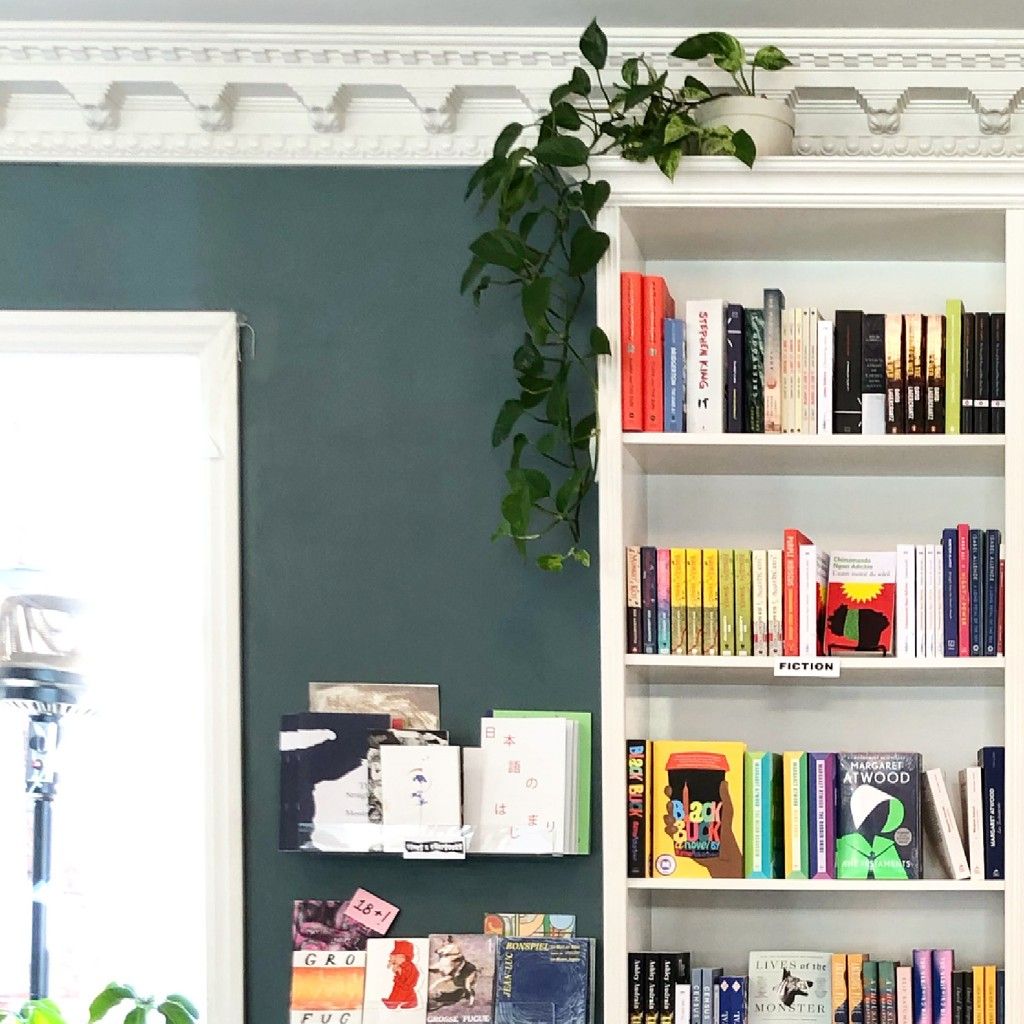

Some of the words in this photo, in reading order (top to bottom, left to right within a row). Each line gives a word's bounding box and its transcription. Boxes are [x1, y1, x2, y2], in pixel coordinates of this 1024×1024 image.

[699, 311, 708, 361] STEPHEN
[699, 363, 708, 389] KING
[778, 662, 834, 671] FICTION
[851, 762, 903, 770] MARGARET
[843, 771, 910, 784] ATWOOD
[353, 898, 391, 924] 18+!
[506, 942, 549, 951] BONSPIEL
[305, 953, 356, 965] GRO
[756, 960, 797, 970] LIVES
[800, 962, 810, 970] of
[812, 963, 826, 971] the
[503, 952, 514, 997] JEAN-LUC
[755, 1003, 826, 1014] MONSTER
[301, 1014, 351, 1024] FUG
